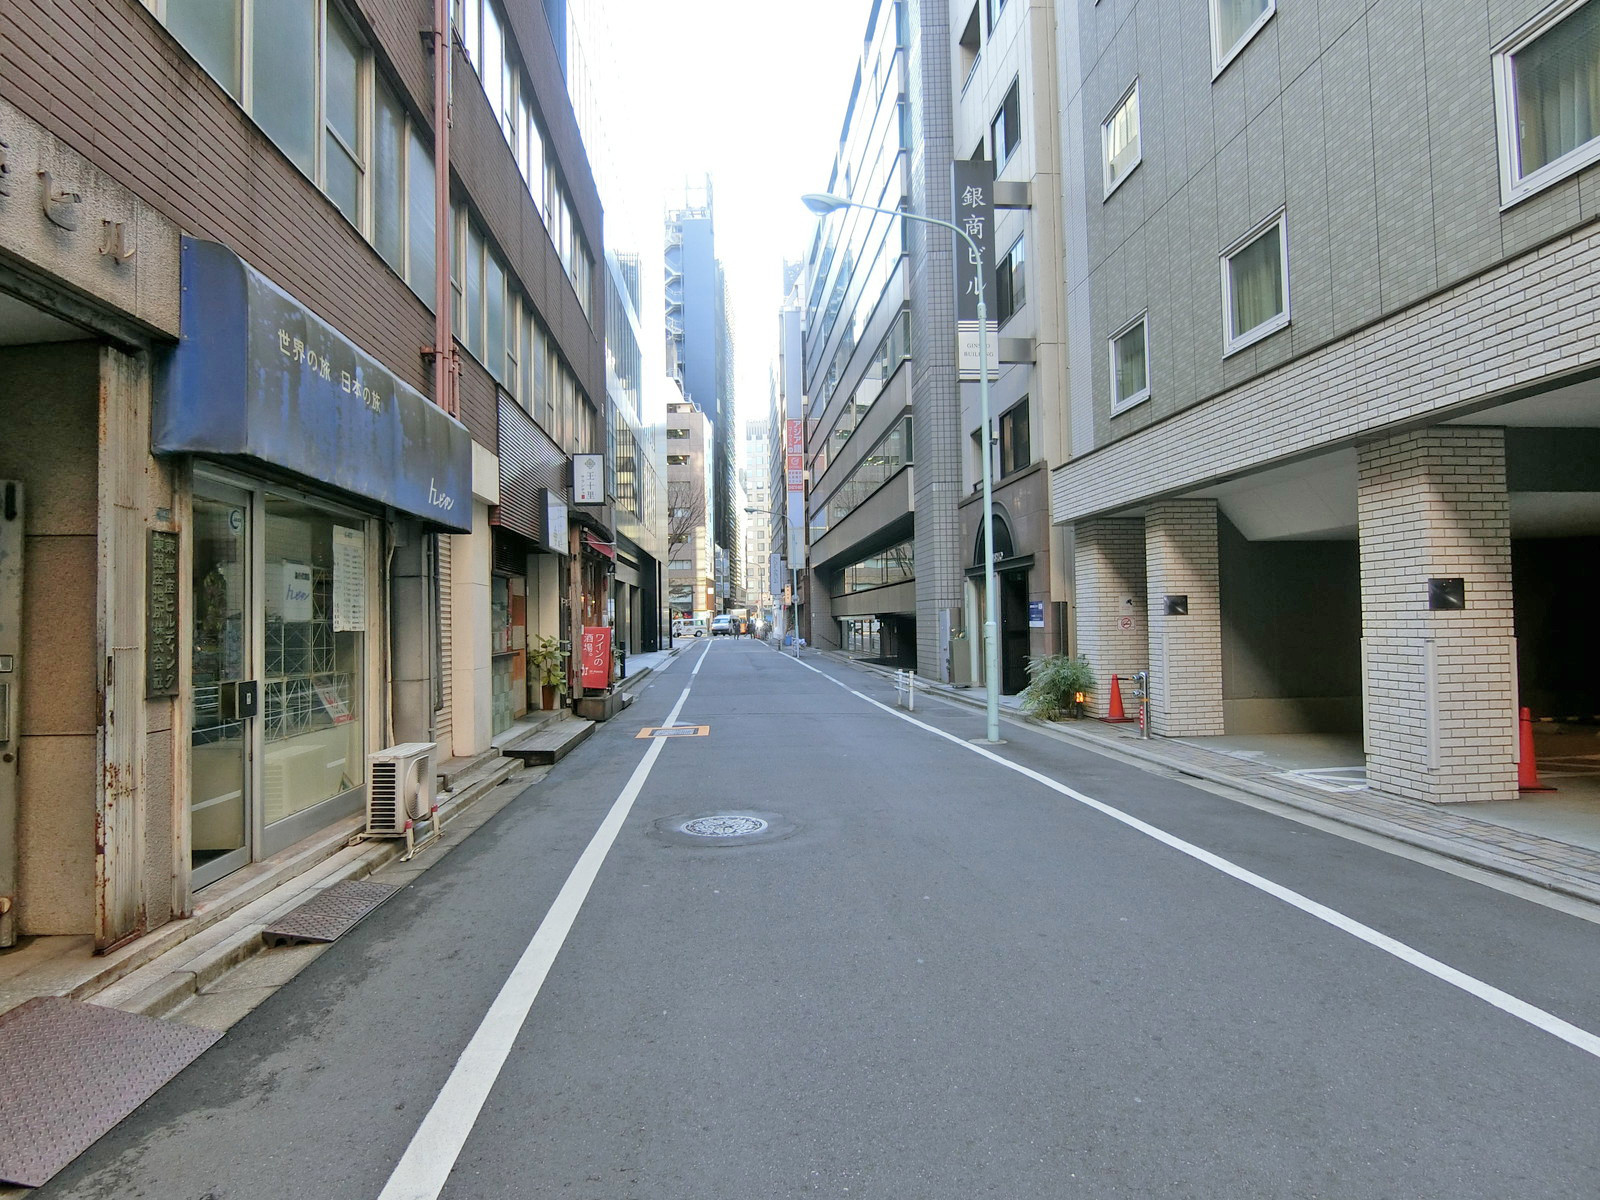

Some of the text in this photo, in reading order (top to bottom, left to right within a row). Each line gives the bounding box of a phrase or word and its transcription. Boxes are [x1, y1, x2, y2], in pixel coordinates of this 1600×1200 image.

[961, 185, 987, 296] 銀商ビル
[277, 328, 382, 414] 世界の旅 日本の旅
[593, 633, 605, 667] ワインの
